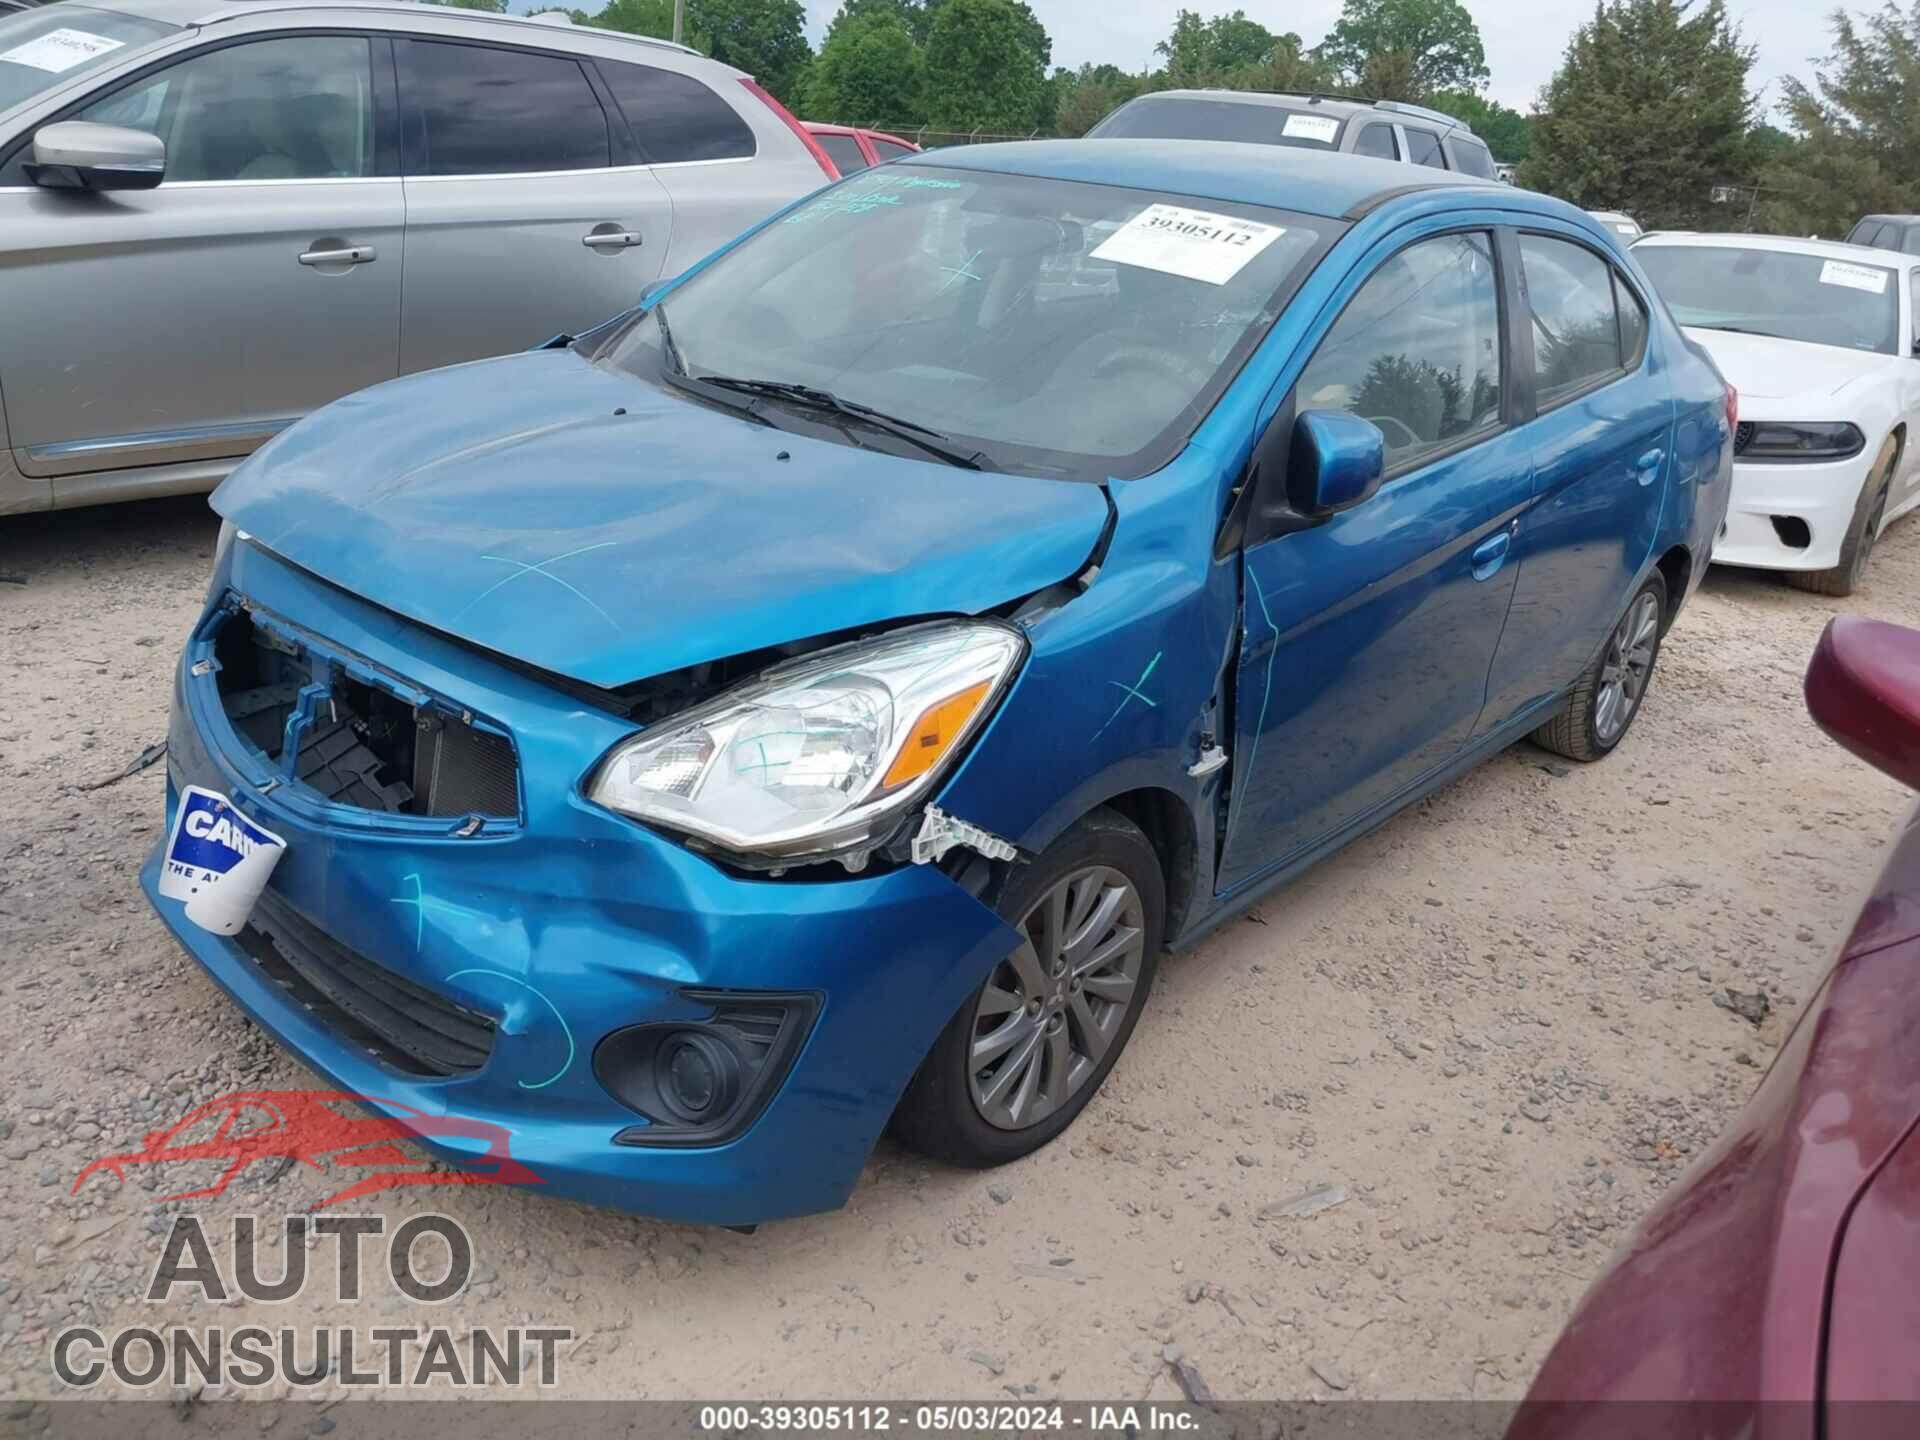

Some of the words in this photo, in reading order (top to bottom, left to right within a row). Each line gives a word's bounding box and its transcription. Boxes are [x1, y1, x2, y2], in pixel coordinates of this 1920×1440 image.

[1142, 216, 1252, 246] 39305112
[167, 861, 195, 878] THE
[202, 872, 218, 883] A
